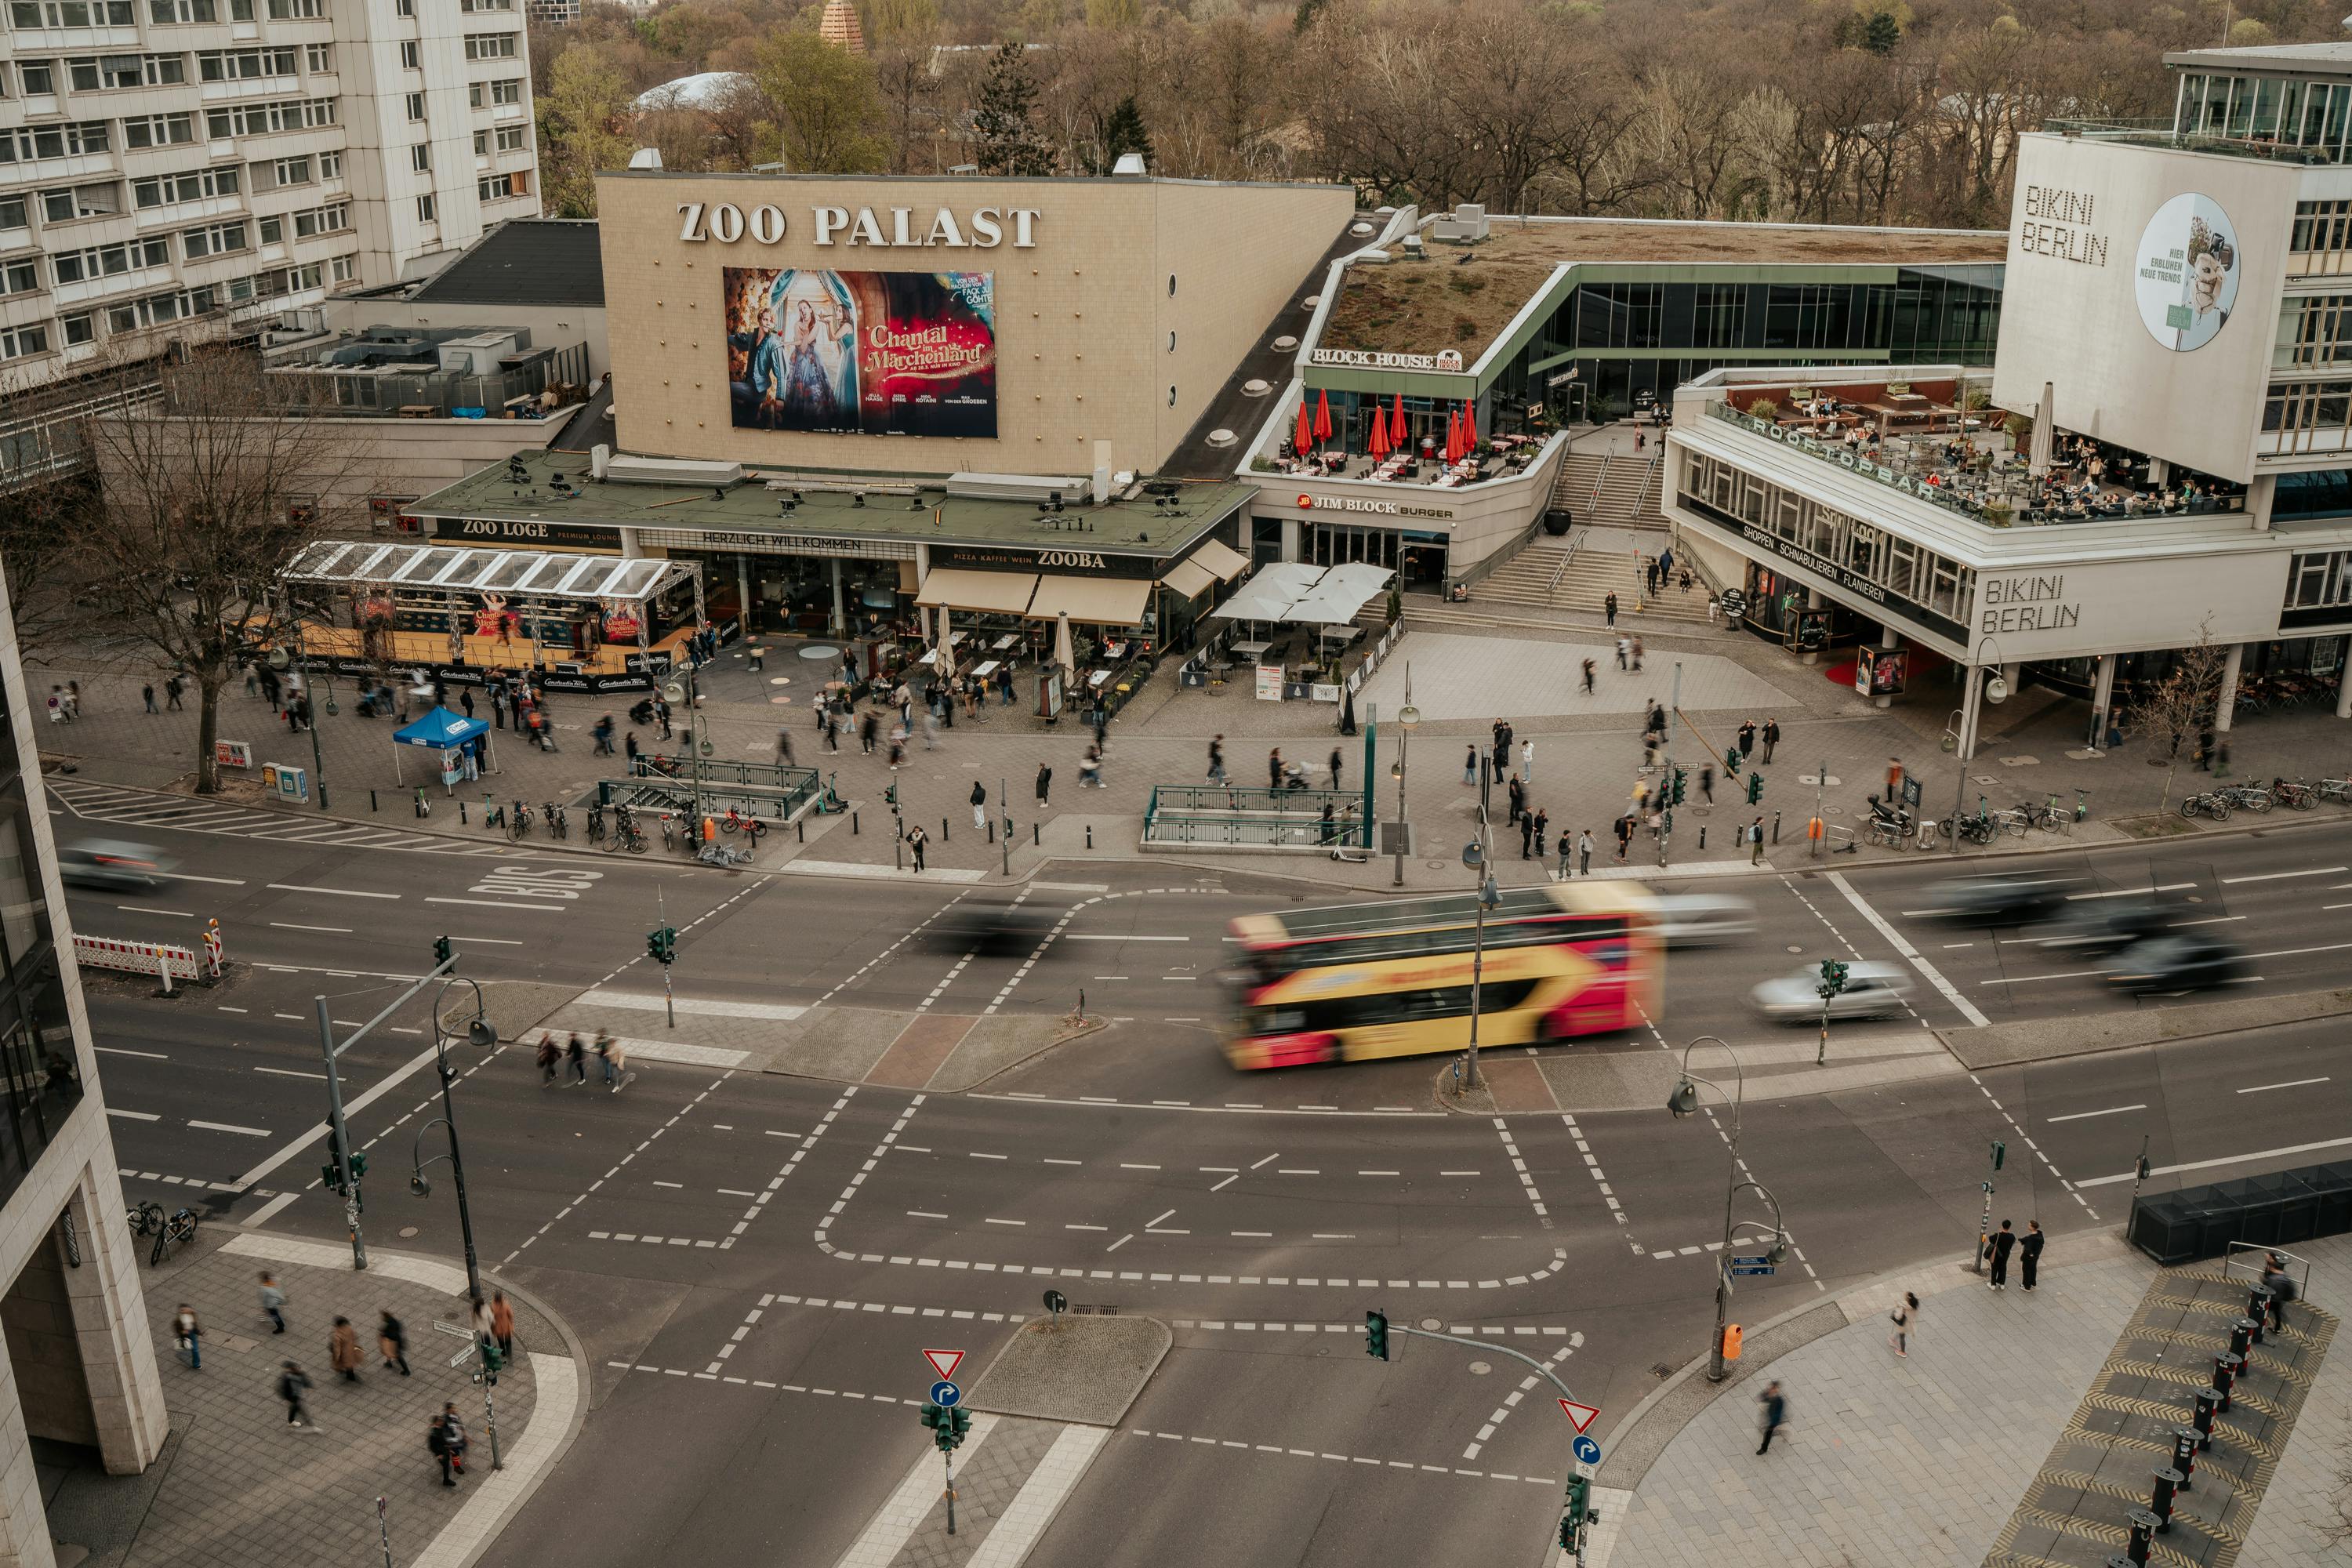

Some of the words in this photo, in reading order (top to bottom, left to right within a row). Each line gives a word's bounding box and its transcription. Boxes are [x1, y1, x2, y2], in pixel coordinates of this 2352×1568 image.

[2026, 185, 2093, 226] BIKINI
[677, 202, 786, 245] ZOO
[811, 205, 1041, 248] PALAST
[2021, 221, 2108, 267] BERLIN
[2169, 248, 2184, 260] HIER
[2140, 267, 2157, 279] NEUE
[2158, 270, 2181, 284] TRENDS
[962, 287, 980, 296] FACK
[870, 325, 947, 350] Chantal
[922, 343, 937, 353] in
[864, 343, 985, 372] Märchenland
[1313, 348, 1371, 366] BLOCK
[1375, 352, 1434, 369] HOUSE
[1753, 418, 1873, 474] ROOFTOP
[1877, 466, 1934, 500] BAR
[1298, 497, 1310, 506] JB
[1315, 497, 1342, 510] JIM
[1345, 499, 1397, 514] BLOCK
[1400, 506, 1453, 518] BURGER
[463, 520, 498, 535] ZOO
[503, 522, 549, 538] LOGE
[703, 531, 765, 546] HERZLICH
[771, 535, 861, 550] WILLKOMMEN
[953, 553, 976, 561] PIZZA
[980, 554, 1007, 563] KAFFEE
[1037, 551, 1106, 568] ZOOBA
[1744, 525, 1774, 550] SHOPPEN
[1780, 543, 1838, 580] SCHNABULIEREN
[1843, 573, 1885, 603] FLANIEREN
[1985, 575, 2063, 604] BIKINI
[1982, 603, 2080, 634] BERLIN
[544, 677, 573, 687] Constantin
[598, 679, 631, 688] Constantin
[467, 866, 604, 899] BUS
